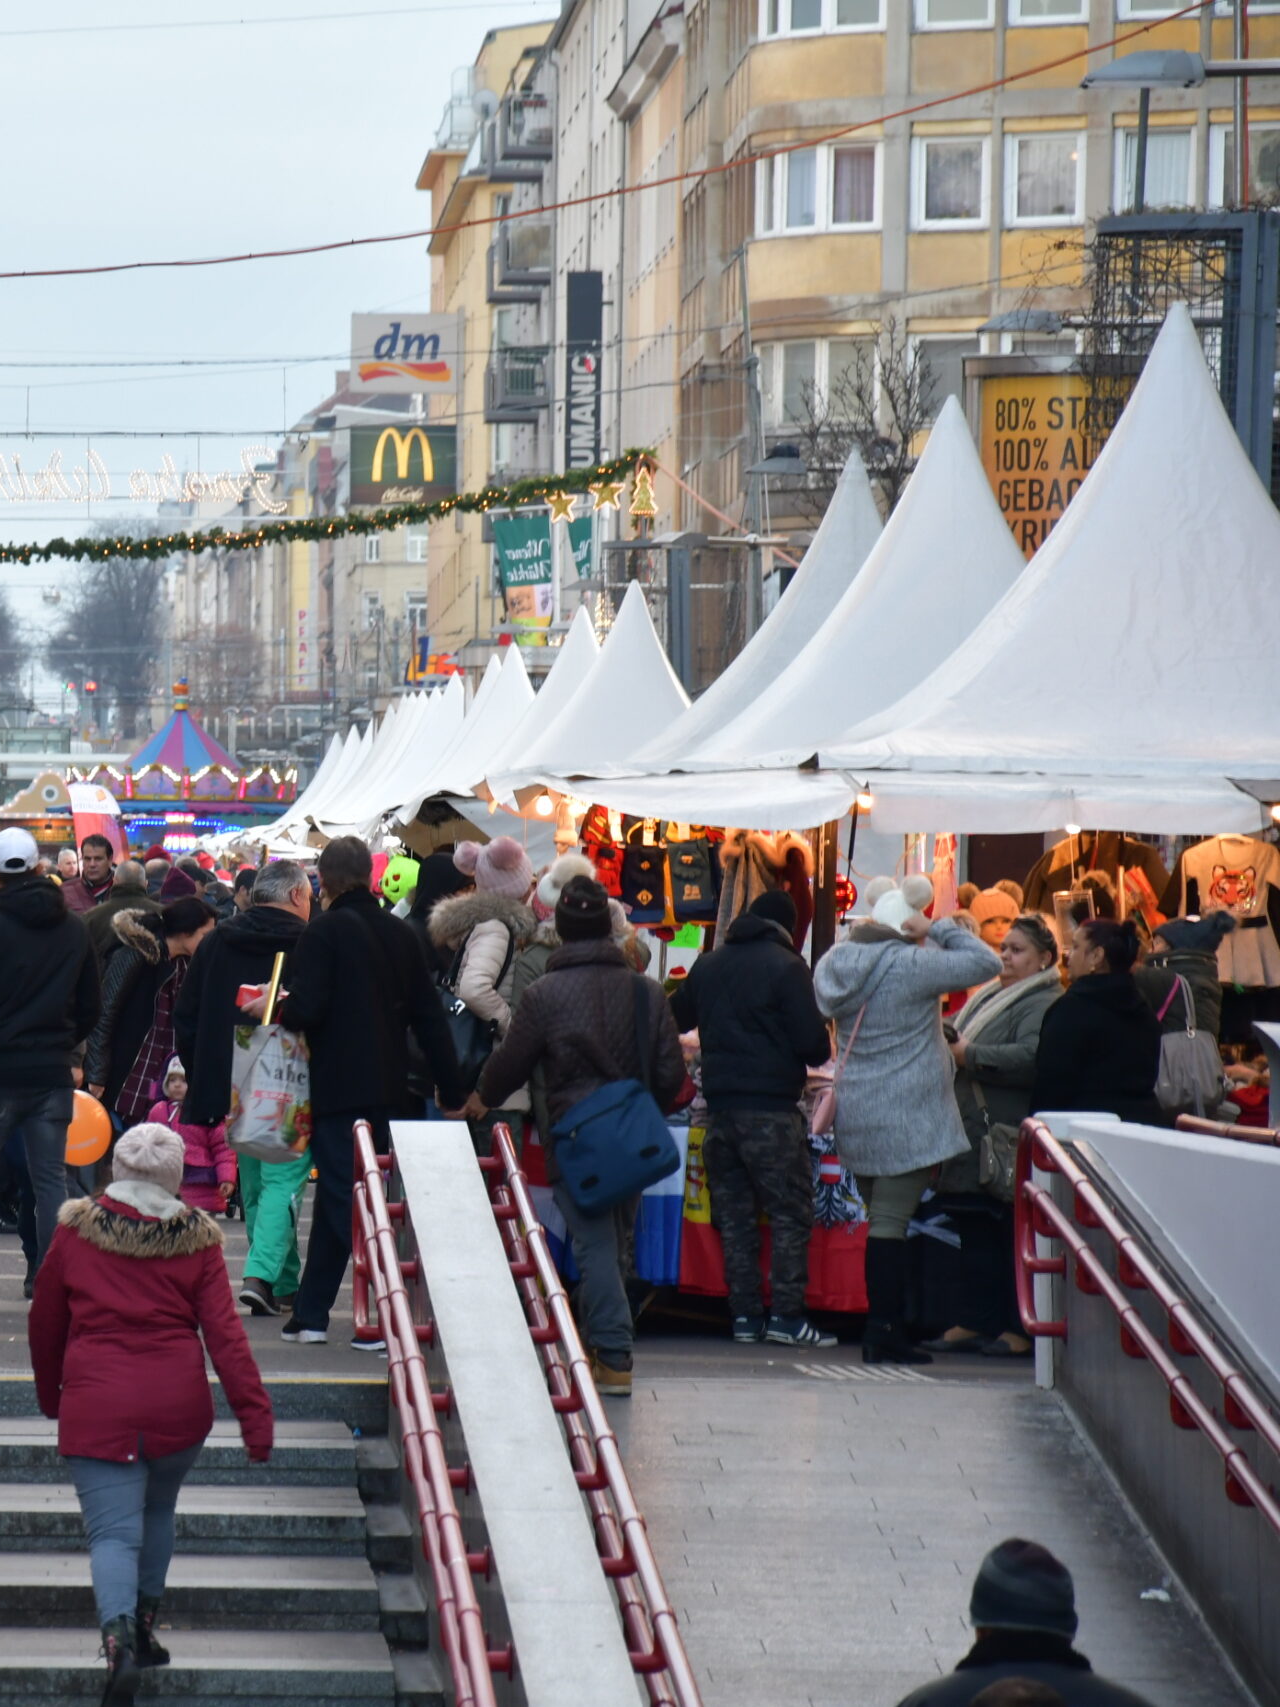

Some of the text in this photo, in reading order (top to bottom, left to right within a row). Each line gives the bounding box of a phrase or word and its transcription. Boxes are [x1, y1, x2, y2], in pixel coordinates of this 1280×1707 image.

[374, 322, 440, 360] dm
[570, 352, 597, 469] UMANIC
[995, 397, 1037, 432] 80%
[994, 437, 1108, 472] 100% AL
[298, 610, 307, 685] PFAFF
